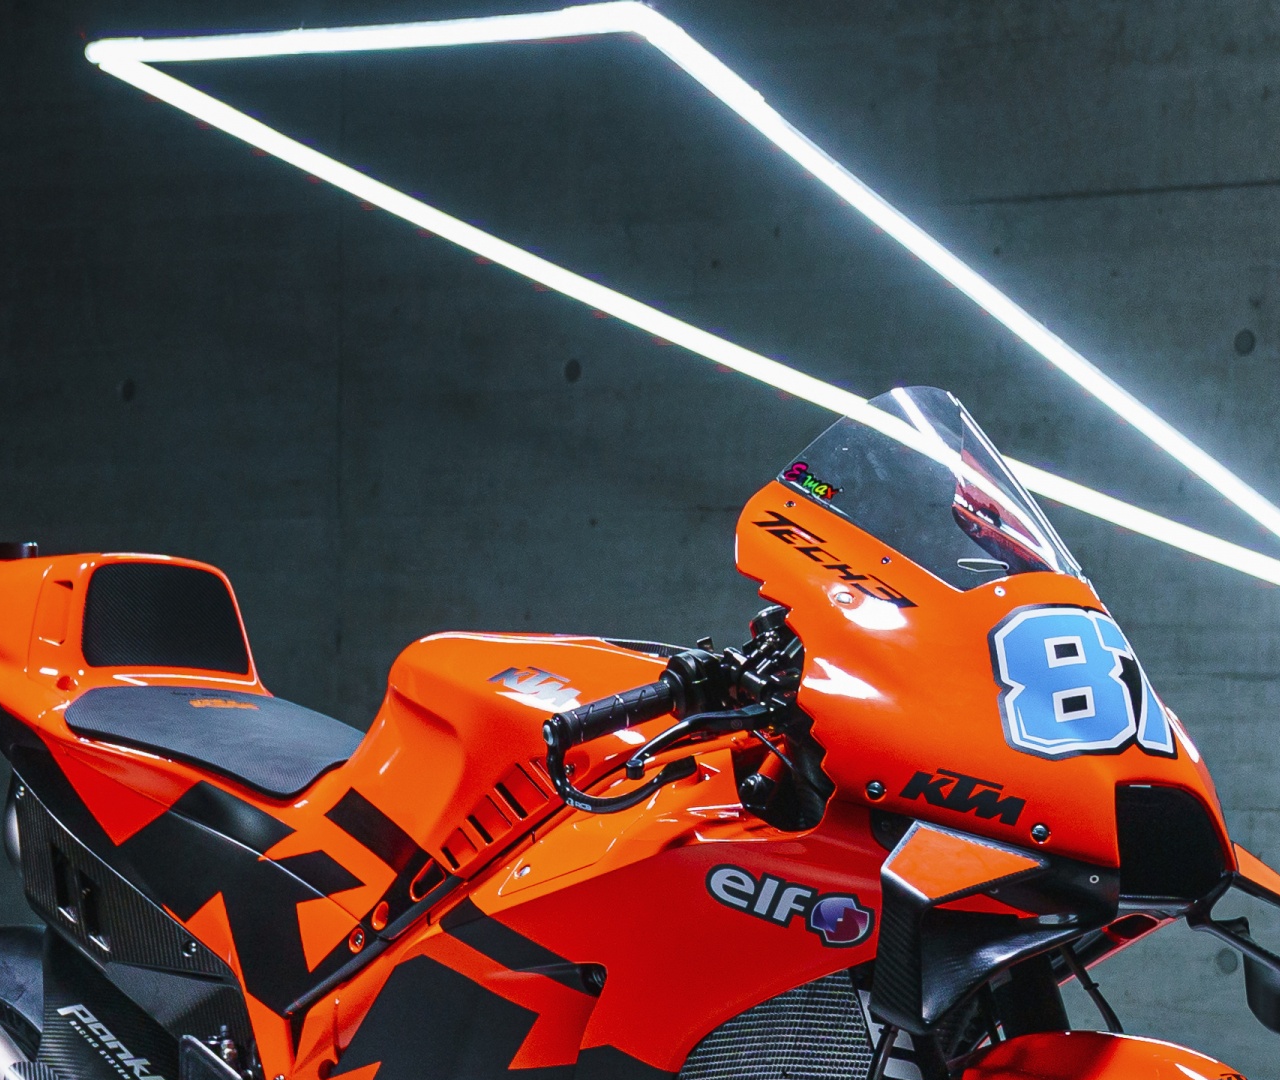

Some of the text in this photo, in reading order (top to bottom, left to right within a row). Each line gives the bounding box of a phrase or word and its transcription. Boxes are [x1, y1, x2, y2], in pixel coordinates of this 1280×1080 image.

[487, 666, 582, 707] KTM
[899, 768, 1027, 826] KTM
[709, 868, 815, 922] elf
